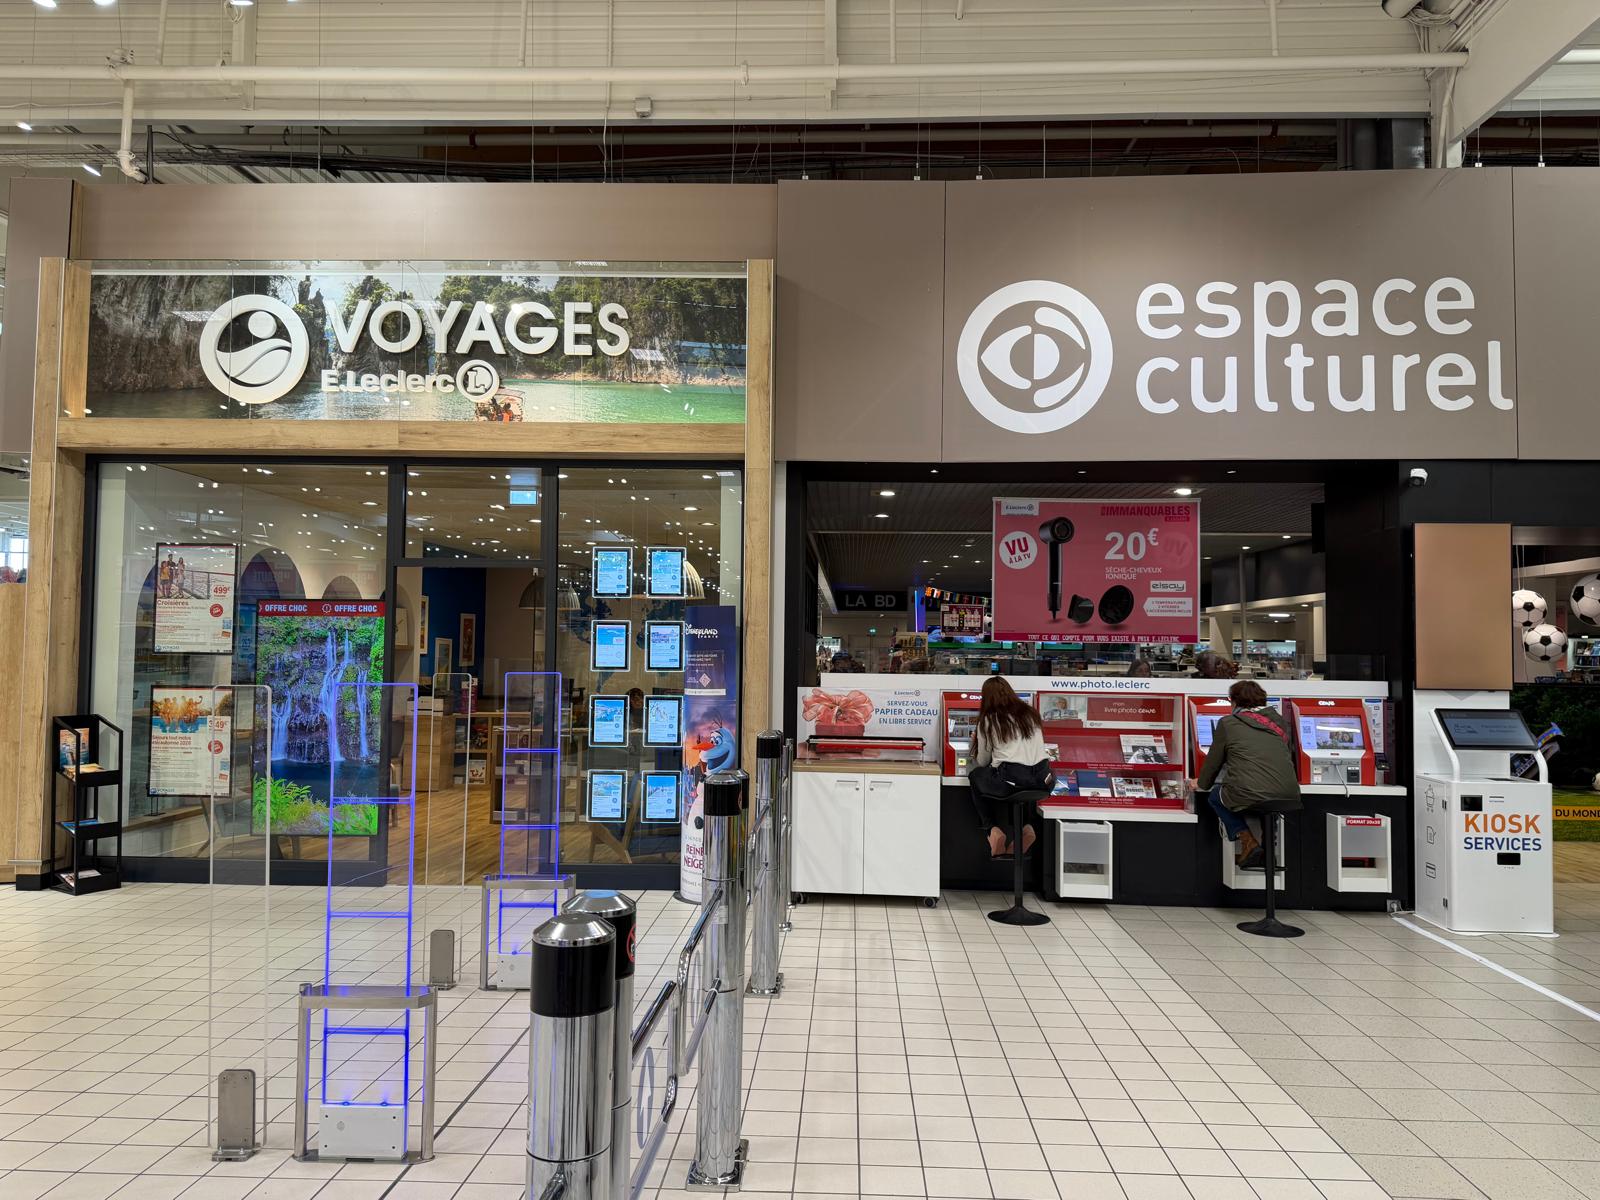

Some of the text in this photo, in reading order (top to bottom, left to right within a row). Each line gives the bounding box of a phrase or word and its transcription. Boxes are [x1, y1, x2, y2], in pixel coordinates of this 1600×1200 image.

[1136, 276, 1475, 350] espace
[326, 299, 630, 357] VOYAGES
[321, 369, 454, 393] E.Leclerc
[1136, 340, 1513, 414] culturel
[1004, 536, 1030, 556] VU
[1104, 528, 1159, 561] 20€
[1014, 555, 1023, 563] LA
[1105, 573, 1137, 581] IONIQUE
[265, 604, 308, 612] OFFRE CHOC
[334, 604, 357, 612] OFFRE
[845, 595, 896, 608] LA BD
[1051, 679, 1151, 690] www.photo.leclerc
[875, 708, 938, 717] PAPIER CADEAU
[1104, 706, 1117, 714] livre
[1118, 707, 1138, 715] photo
[1555, 808, 1570, 817] DU
[1464, 813, 1542, 834] KIOSK
[1464, 837, 1542, 851] SERVICES
